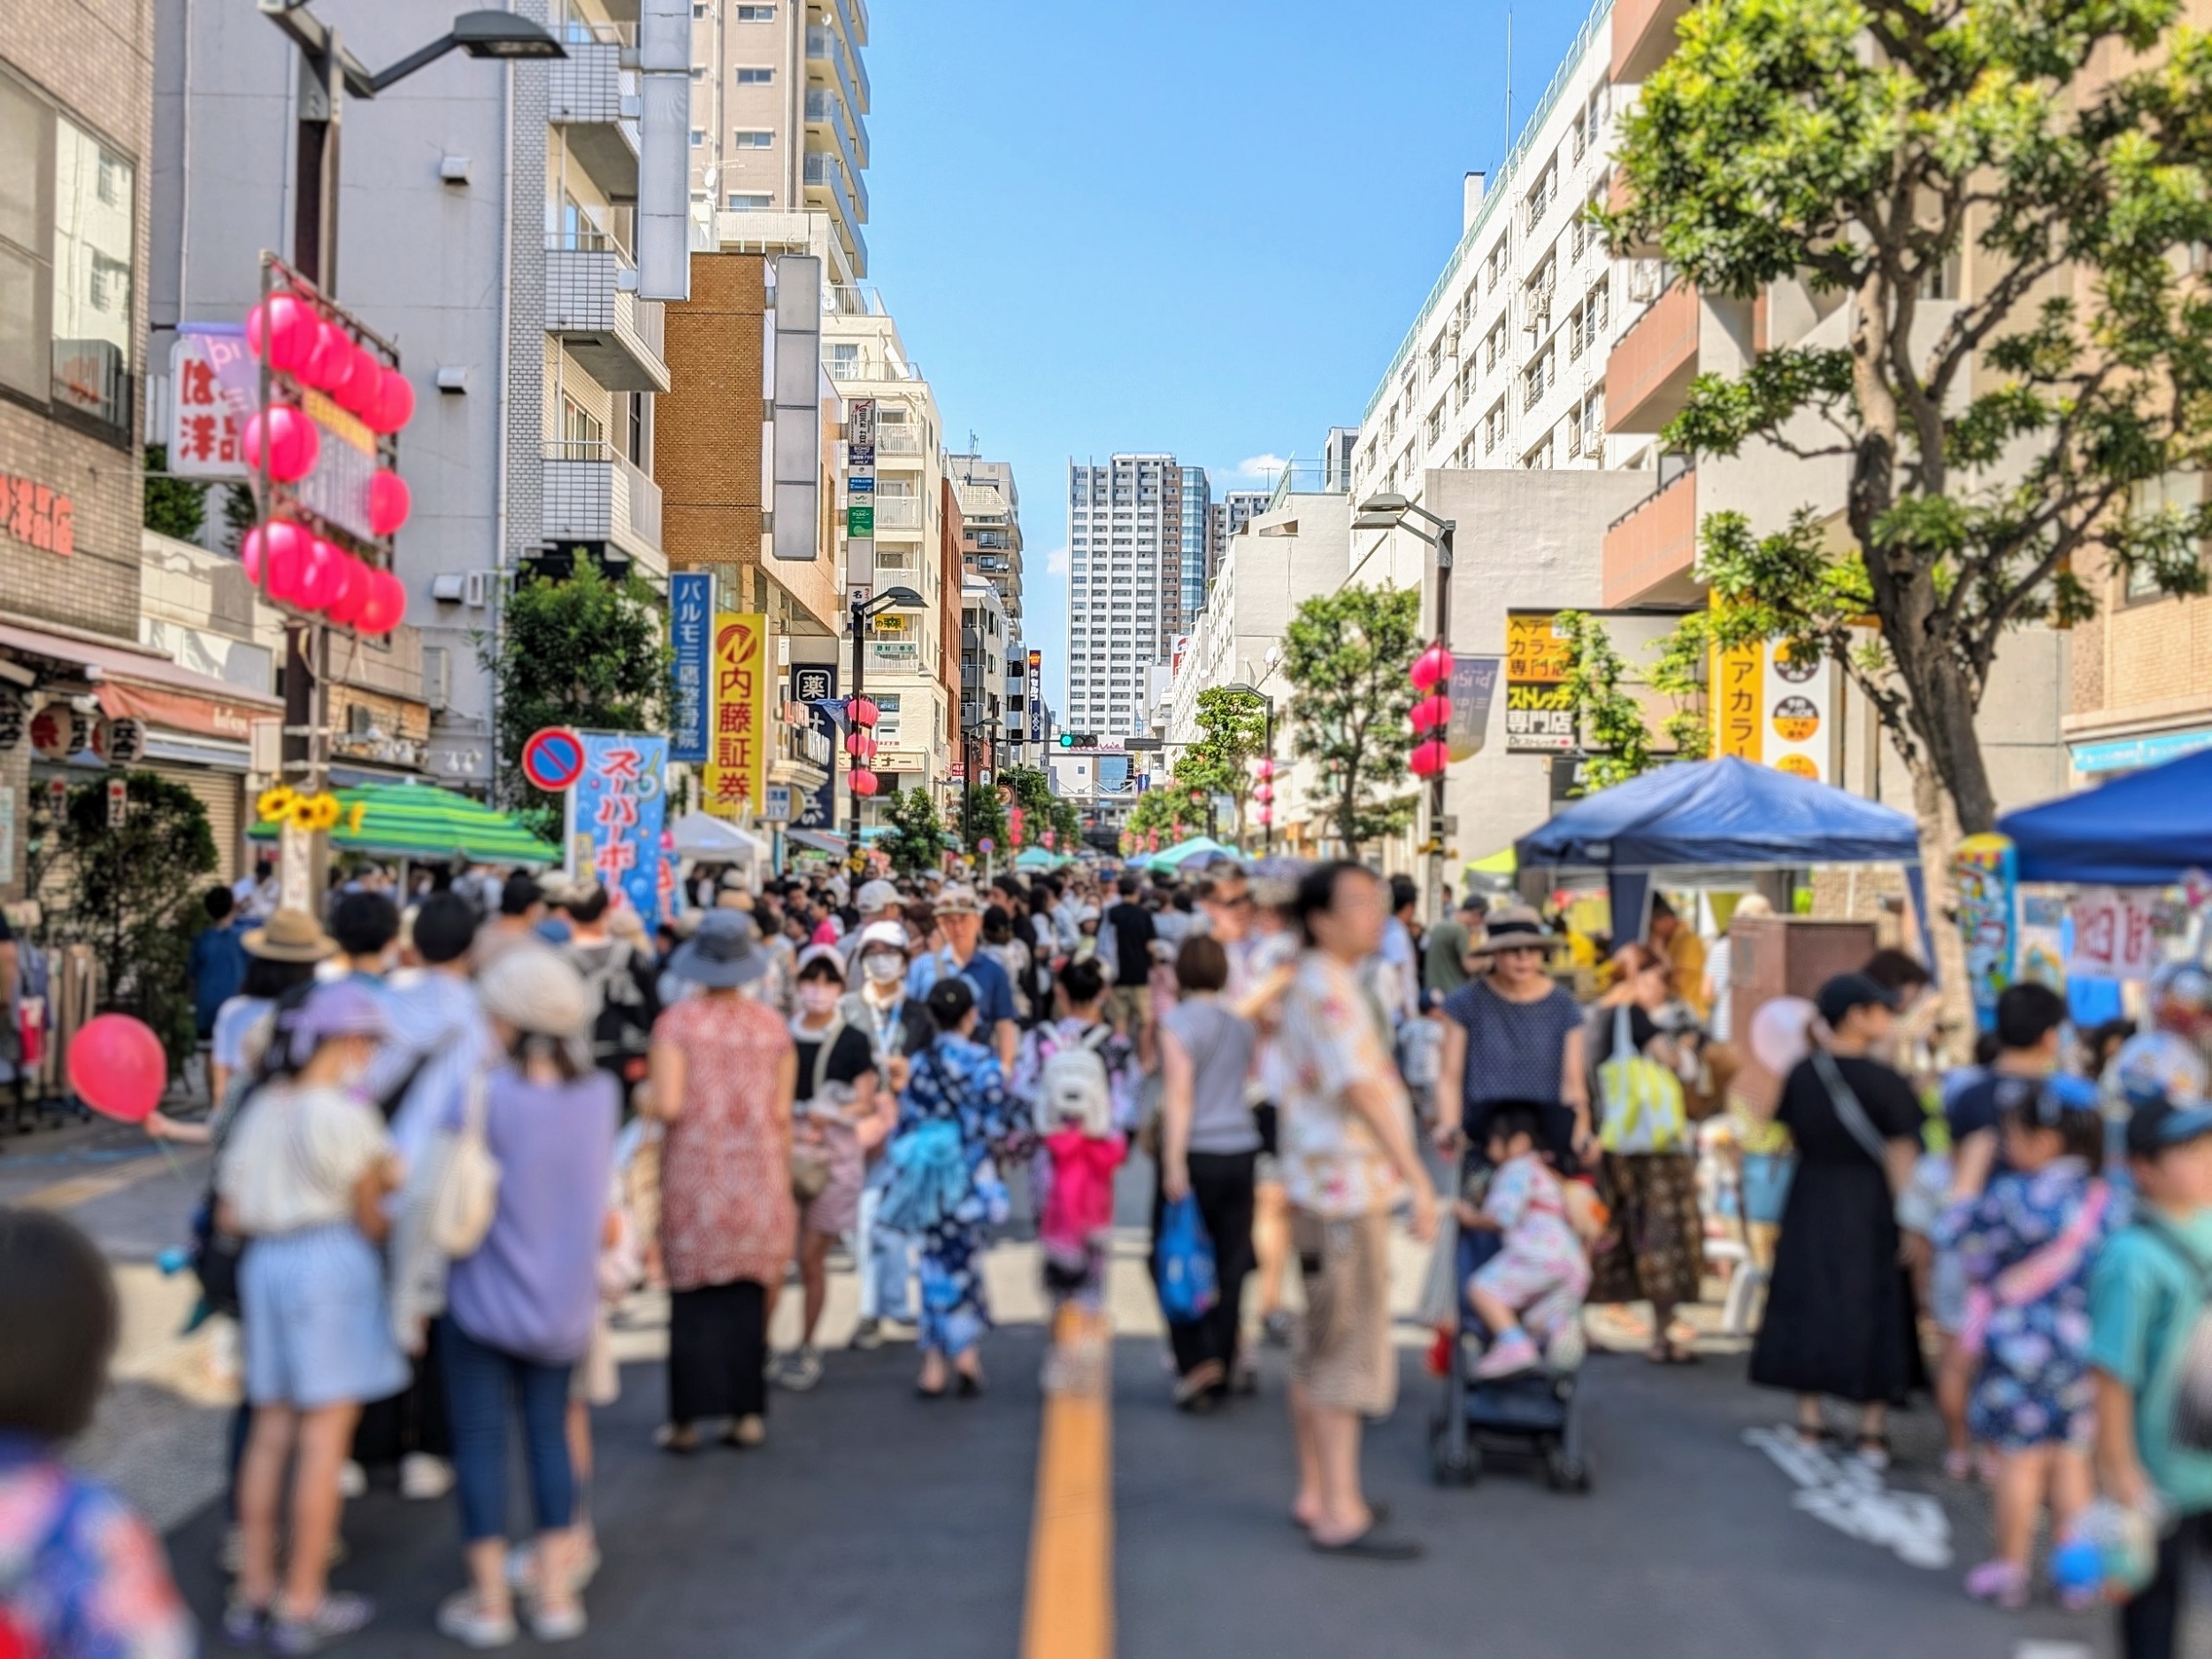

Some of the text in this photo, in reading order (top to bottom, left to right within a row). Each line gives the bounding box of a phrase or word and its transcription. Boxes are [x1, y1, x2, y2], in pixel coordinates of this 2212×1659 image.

[678, 580, 703, 749] パルモ三鷹整骨院
[802, 675, 826, 699] 薬
[1509, 687, 1572, 710] ストレッチ
[1508, 710, 1572, 733] 専門店
[718, 666, 752, 804] 内藤証券
